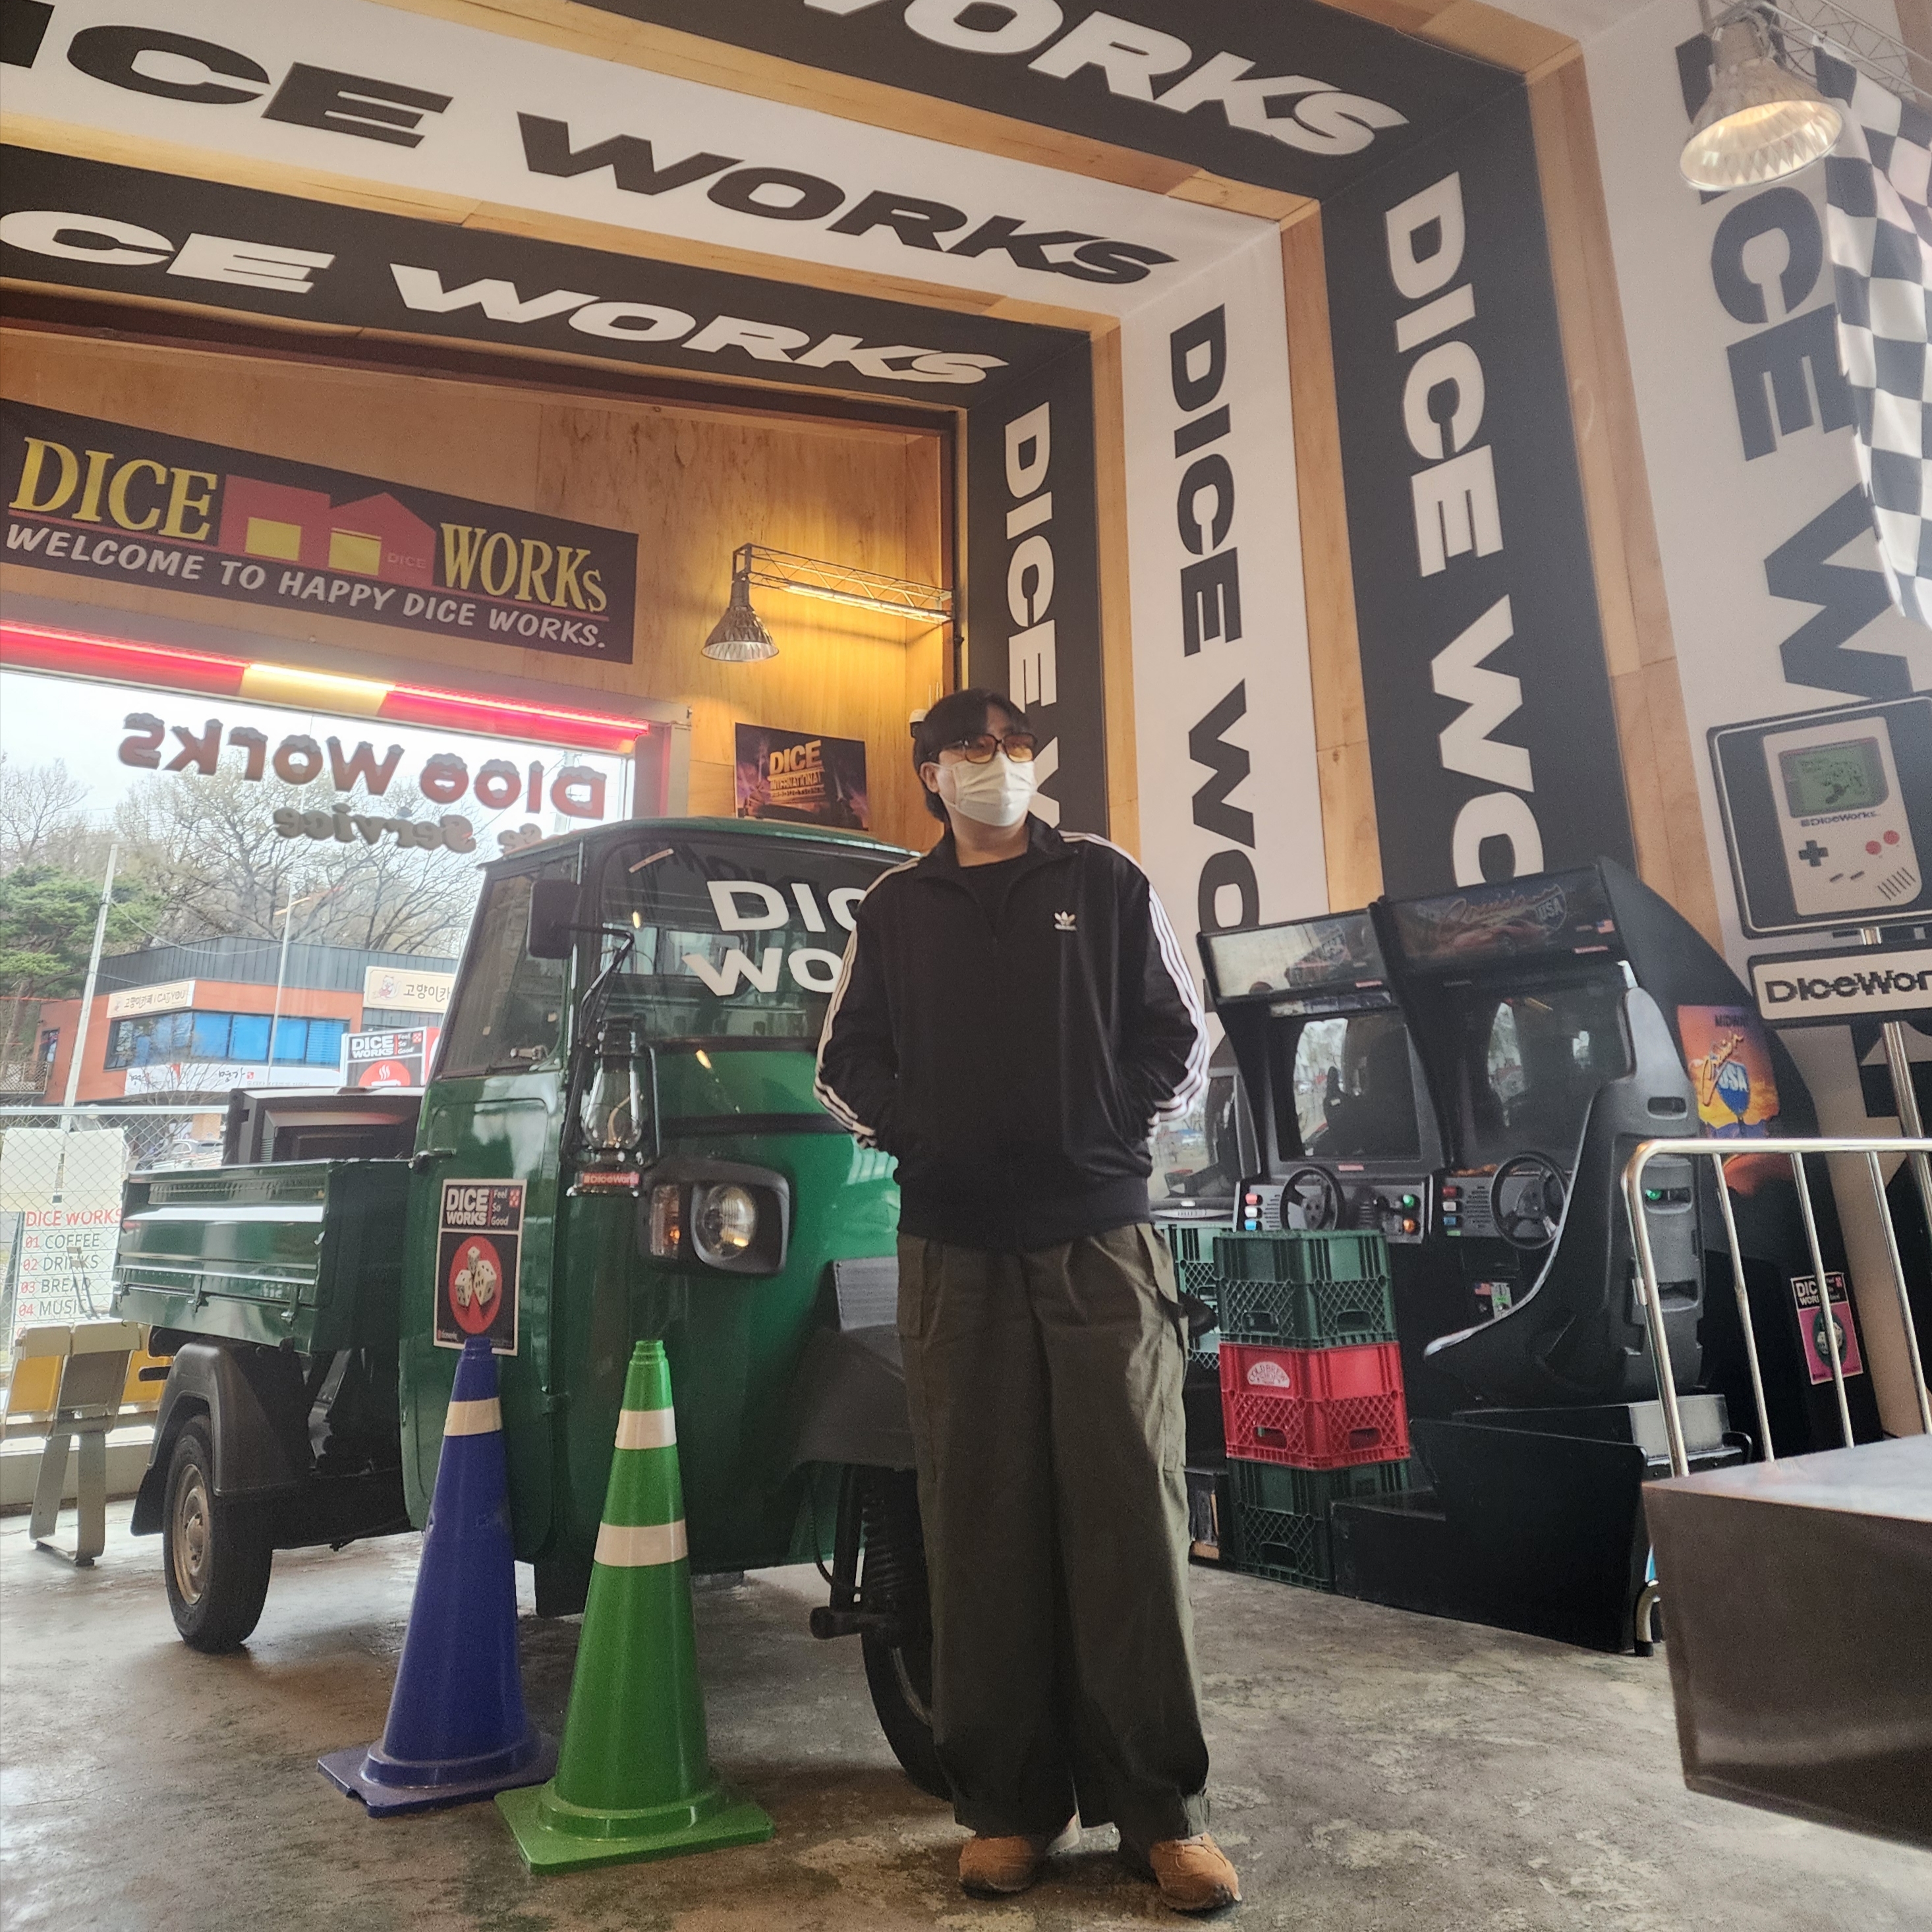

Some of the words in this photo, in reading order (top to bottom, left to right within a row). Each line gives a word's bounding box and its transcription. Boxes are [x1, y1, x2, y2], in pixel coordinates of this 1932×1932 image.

[801, 0, 1409, 156] ORKS
[517, 111, 1179, 284] WORKS
[390, 264, 1009, 384] WORKS
[1385, 171, 1504, 577] DICE
[9, 436, 218, 542] DICE
[1170, 303, 1243, 657] DICE
[387, 552, 428, 570] DICE
[1005, 402, 1057, 714] DICE
[6, 524, 204, 580] WELCOME
[220, 561, 266, 590] TO
[278, 571, 397, 611] HAPPY
[403, 592, 476, 626] DICE
[490, 609, 606, 648] WORKS.
[770, 739, 823, 776] DICE
[351, 1035, 394, 1051] DICE
[352, 1048, 394, 1058] WORKS
[1718, 1063, 1749, 1092] USA
[446, 1188, 490, 1212] DICE
[494, 1189, 508, 1199] Feel
[492, 1203, 501, 1212] So
[26, 1210, 63, 1227] DICE
[446, 1211, 487, 1226] WORKS
[491, 1214, 509, 1226] Good
[25, 1236, 40, 1249] 01
[45, 1233, 100, 1249] COFFEE
[23, 1259, 38, 1271] 02
[43, 1255, 99, 1271] DRIKS
[21, 1282, 36, 1293] 03
[18, 1304, 34, 1317] 04
